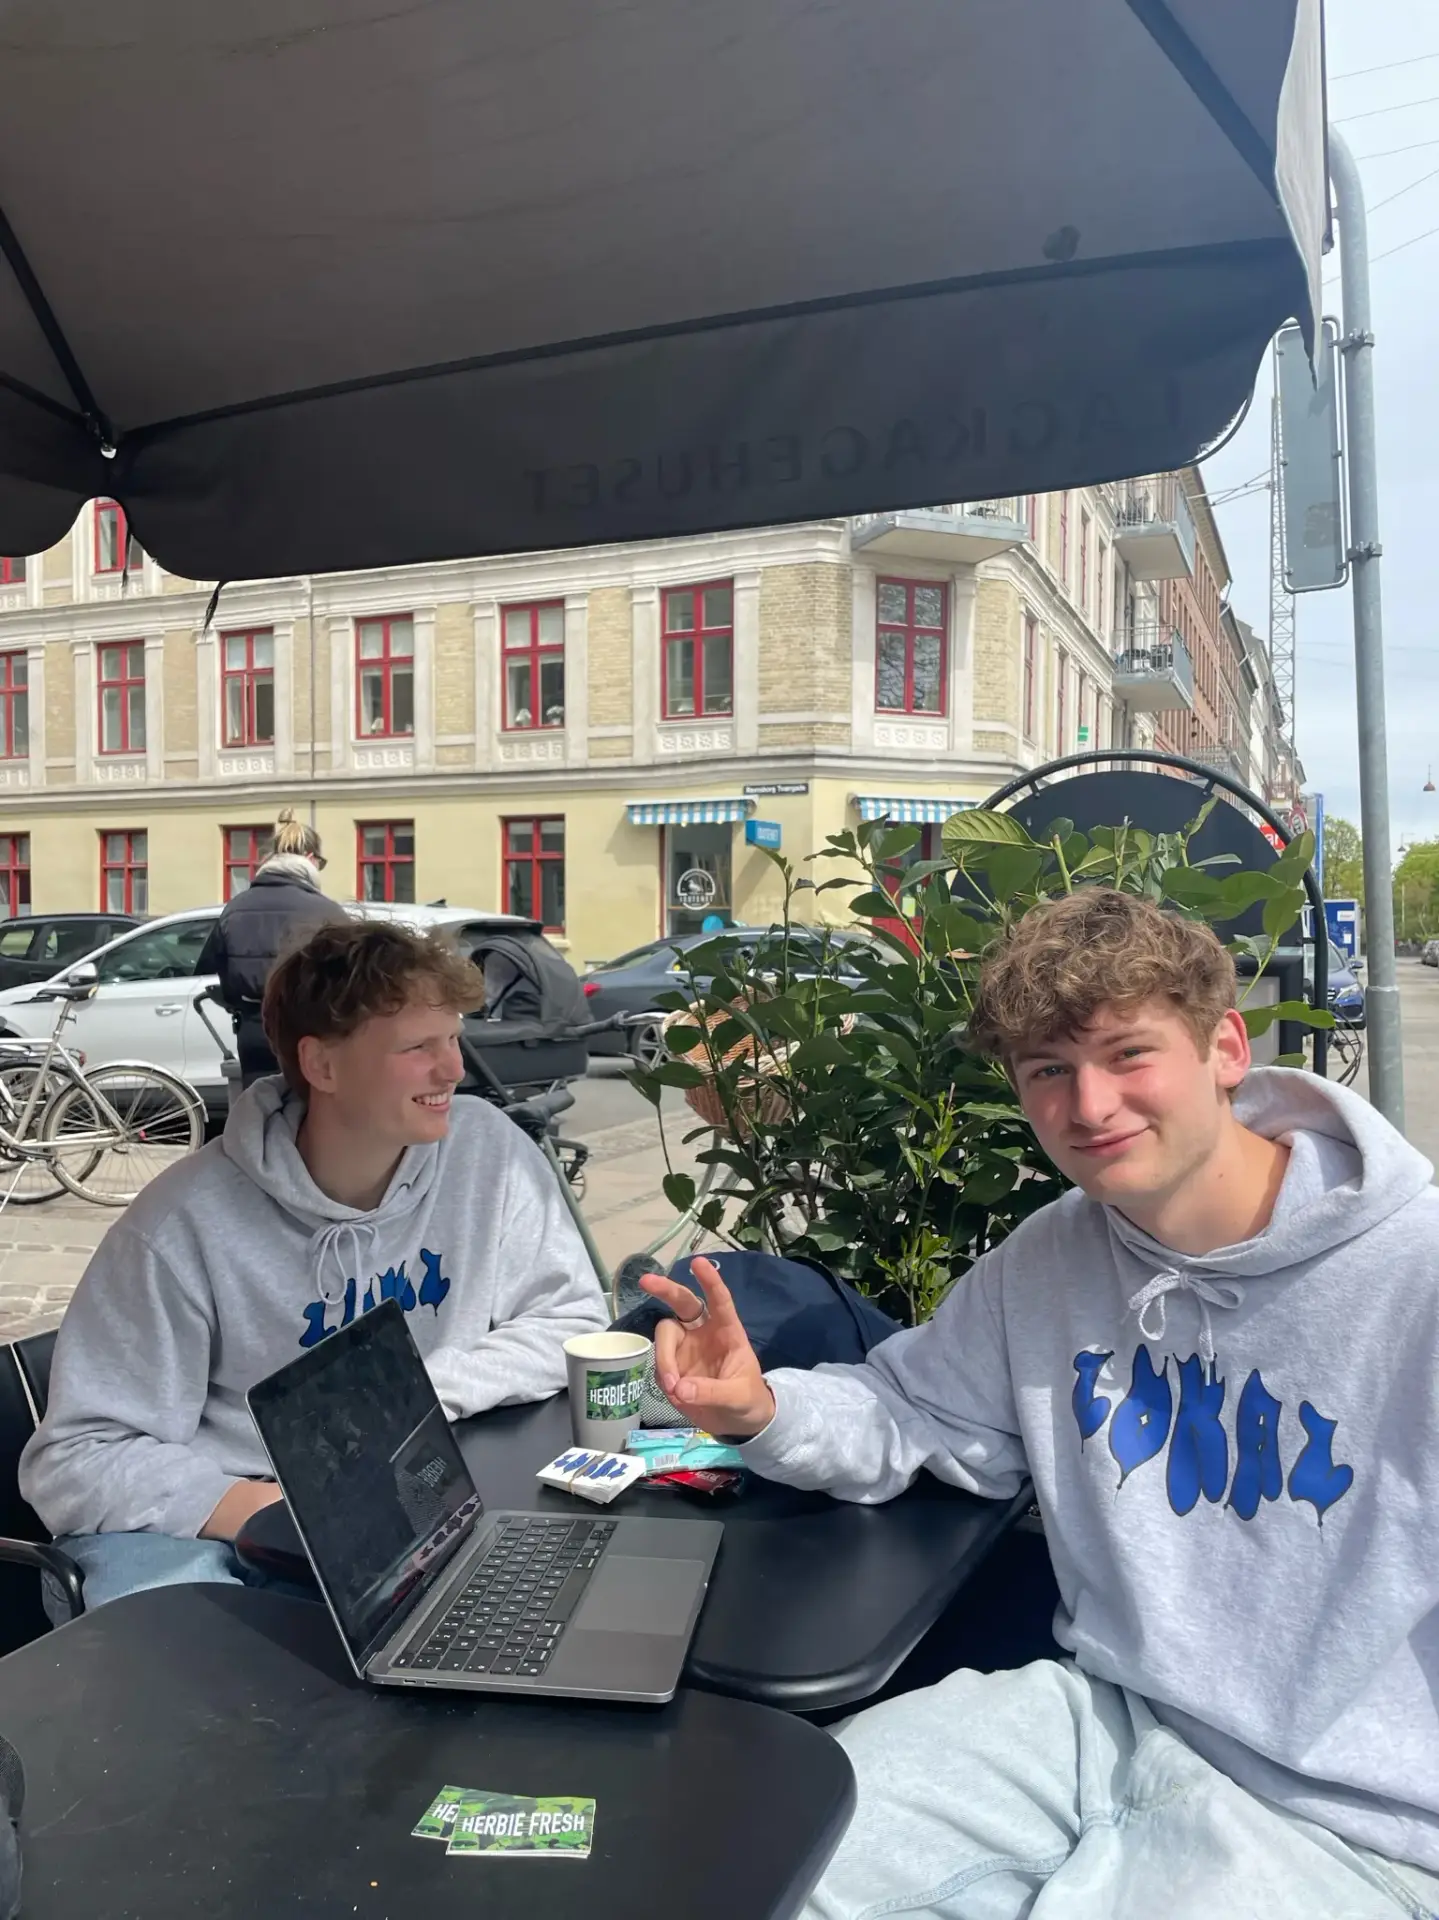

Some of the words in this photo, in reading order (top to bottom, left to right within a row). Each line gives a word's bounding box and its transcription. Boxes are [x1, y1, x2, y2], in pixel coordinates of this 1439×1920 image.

[590, 1383, 627, 1406] HERBIE
[462, 1812, 526, 1837] HERBIE
[528, 1812, 586, 1837] FRESH
